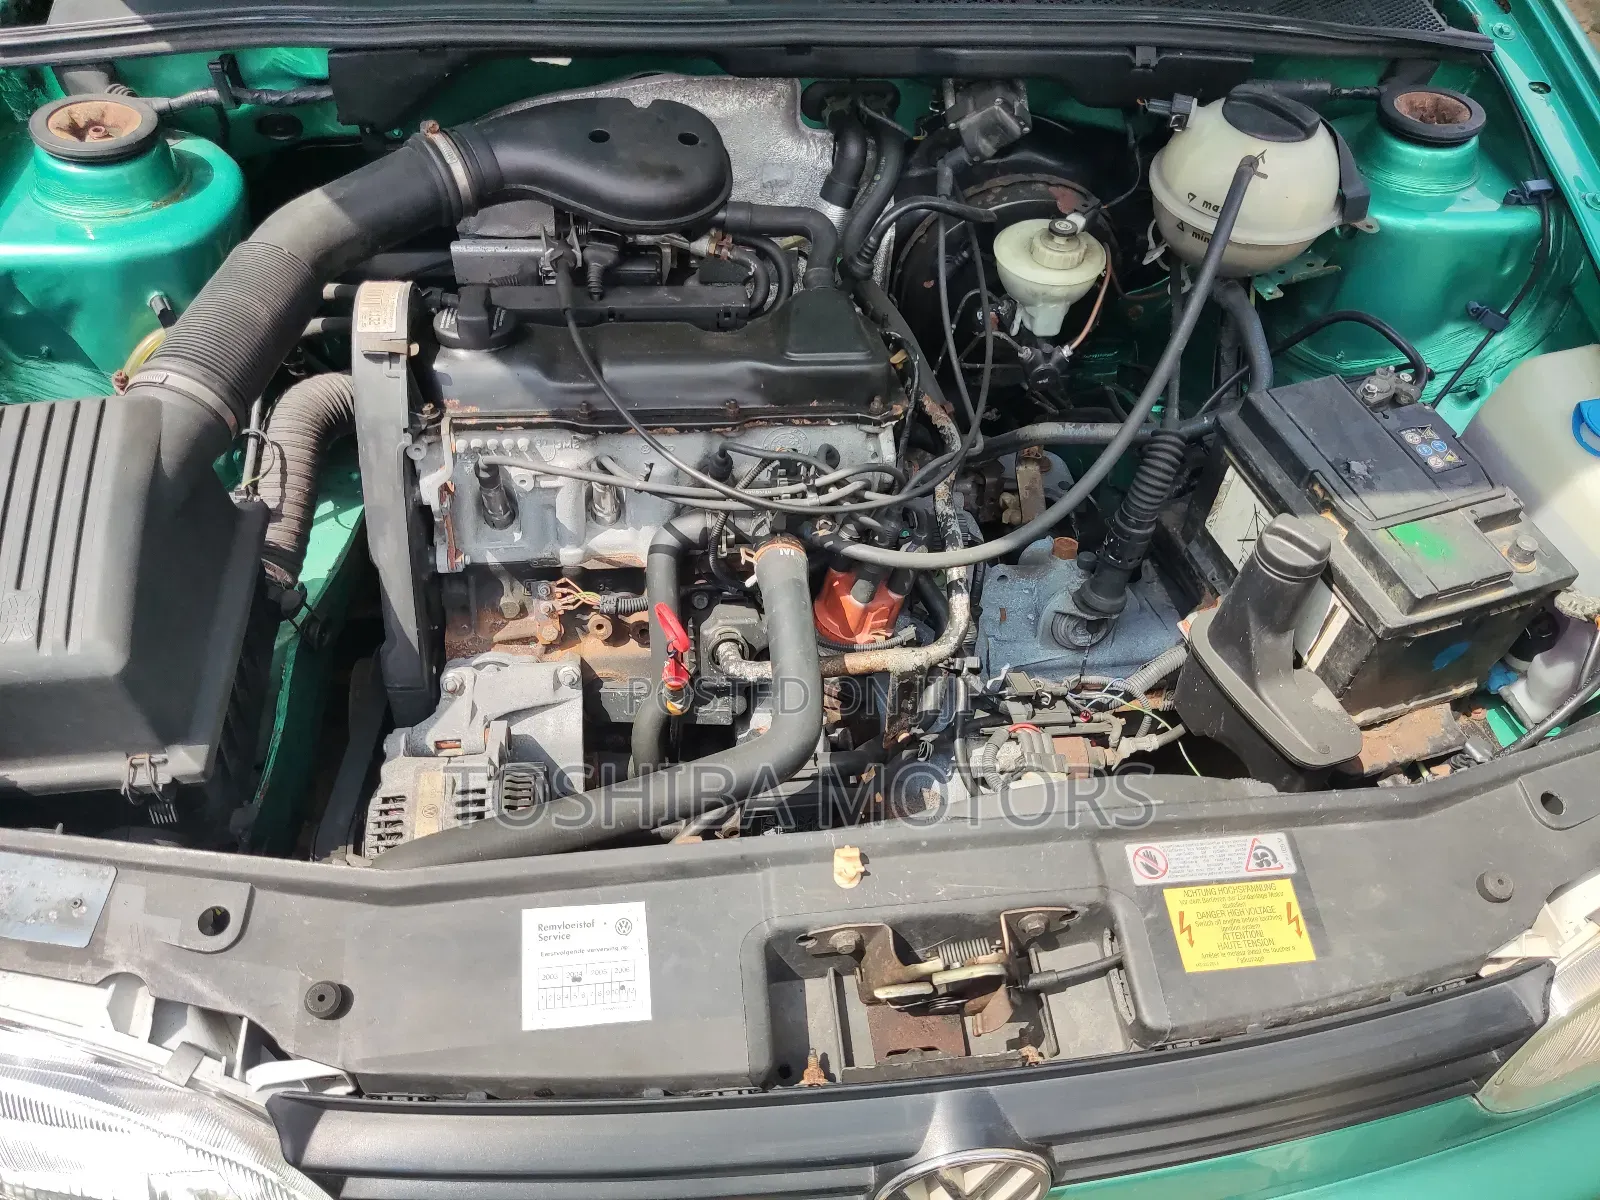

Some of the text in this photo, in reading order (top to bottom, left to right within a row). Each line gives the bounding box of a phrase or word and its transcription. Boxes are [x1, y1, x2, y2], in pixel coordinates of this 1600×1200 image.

[1202, 200, 1221, 213] ma
[1183, 883, 1277, 898] ACHTUNG HOCHSPANNUNG
[1196, 905, 1277, 920] DANGER HIGH VOLTAGE
[537, 918, 595, 932] Remvloeistof
[538, 931, 571, 942] Service
[1217, 938, 1275, 950] HAUTE TENSION
